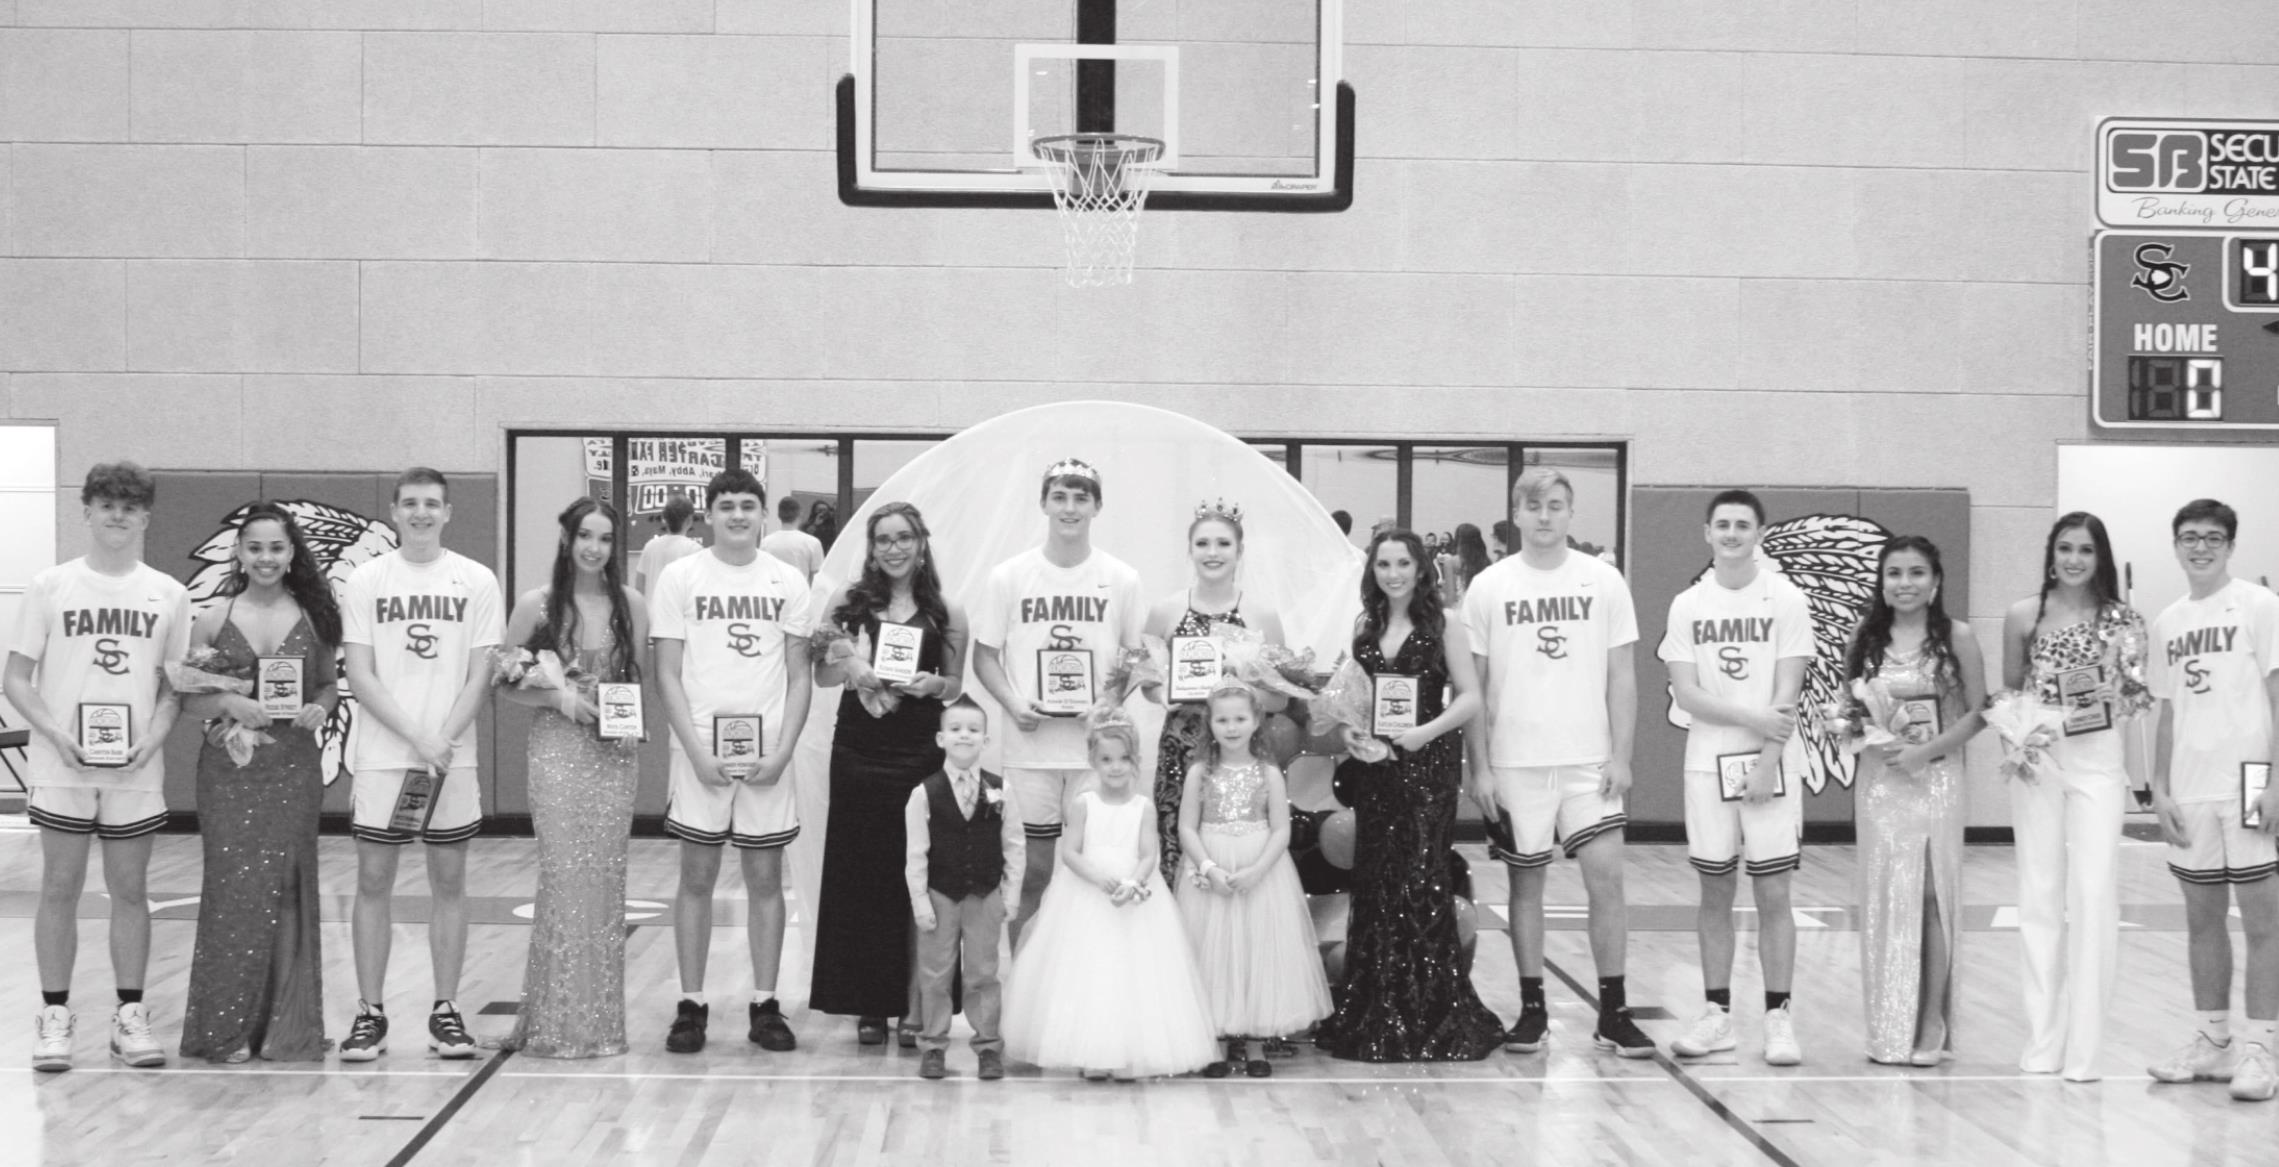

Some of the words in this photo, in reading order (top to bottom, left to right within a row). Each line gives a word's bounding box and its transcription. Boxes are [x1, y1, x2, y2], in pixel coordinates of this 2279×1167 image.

[2209, 165, 2277, 190] STATE
[2130, 196, 2214, 224] Banking
[2223, 197, 2279, 224] Gene
[2134, 323, 2218, 351] HOME
[375, 594, 468, 624] FAMILY
[695, 595, 786, 622] FAMILY
[1021, 595, 1108, 623] FAMILY
[1504, 596, 1593, 626] FAMILY
[63, 607, 159, 639] FAMILY
[1692, 617, 1774, 646] FAMILY
